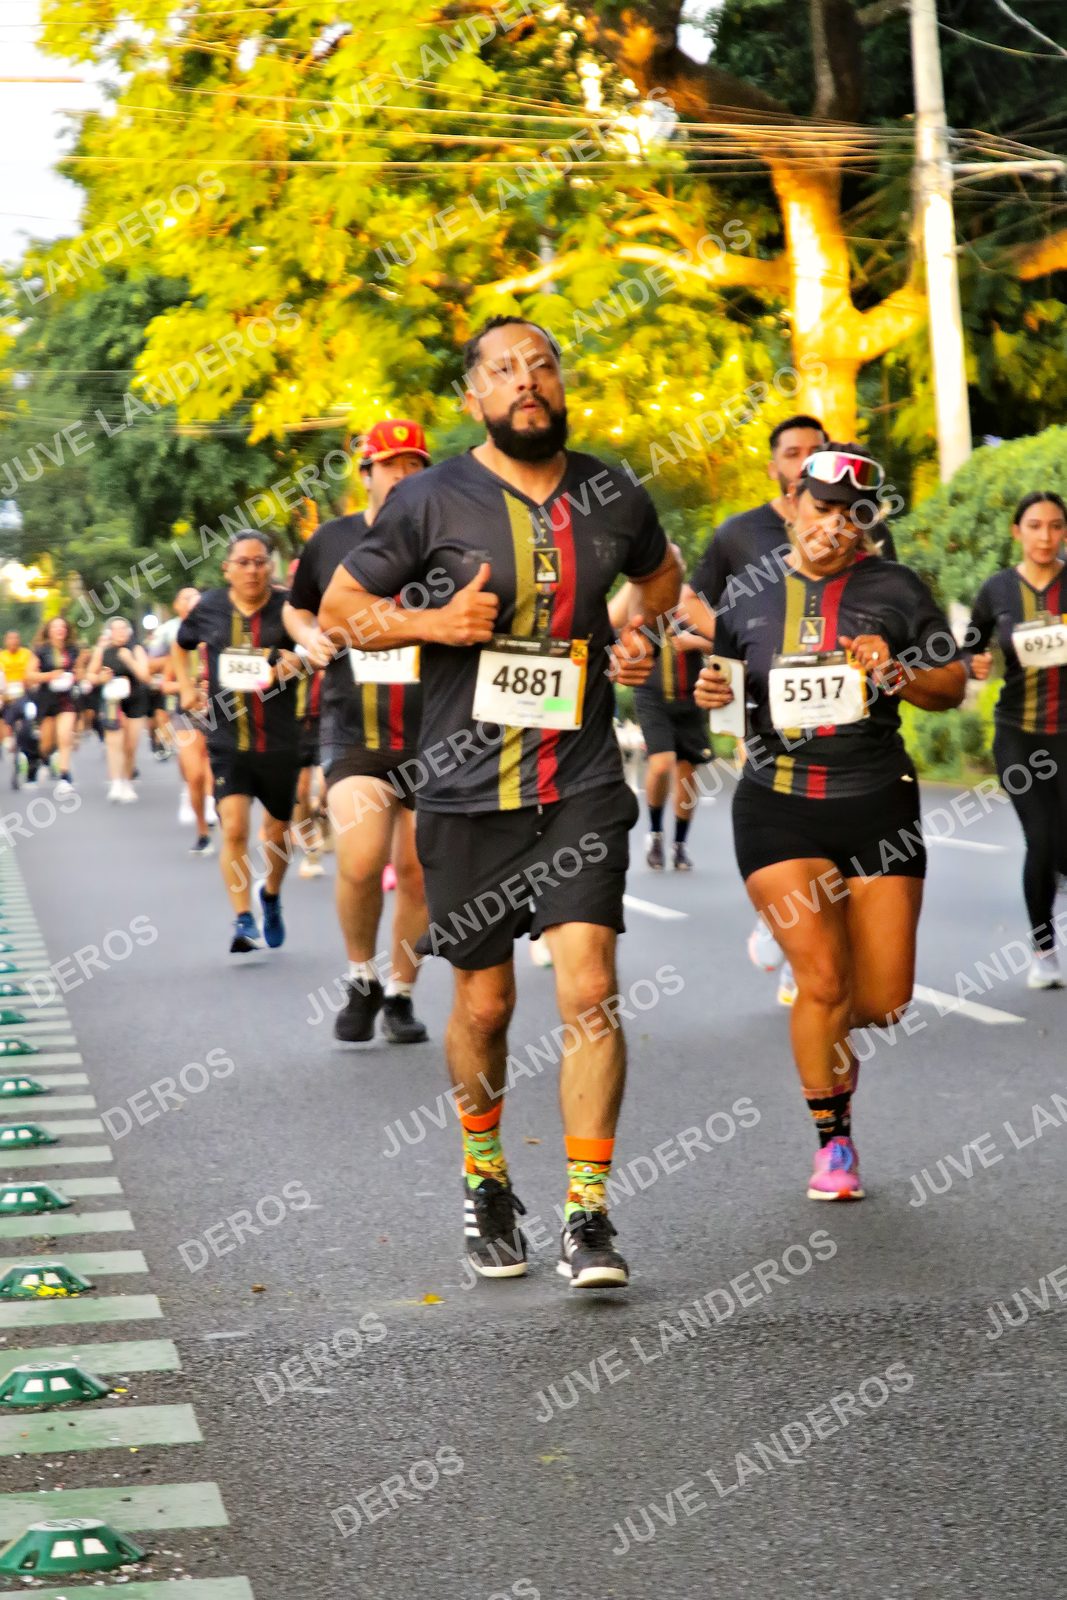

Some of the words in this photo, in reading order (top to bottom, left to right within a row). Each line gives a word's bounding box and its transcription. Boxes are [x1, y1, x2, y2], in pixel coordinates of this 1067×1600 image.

[1024, 632, 1064, 652] 6925
[492, 665, 562, 697] 4881
[784, 675, 845, 702] 5517
